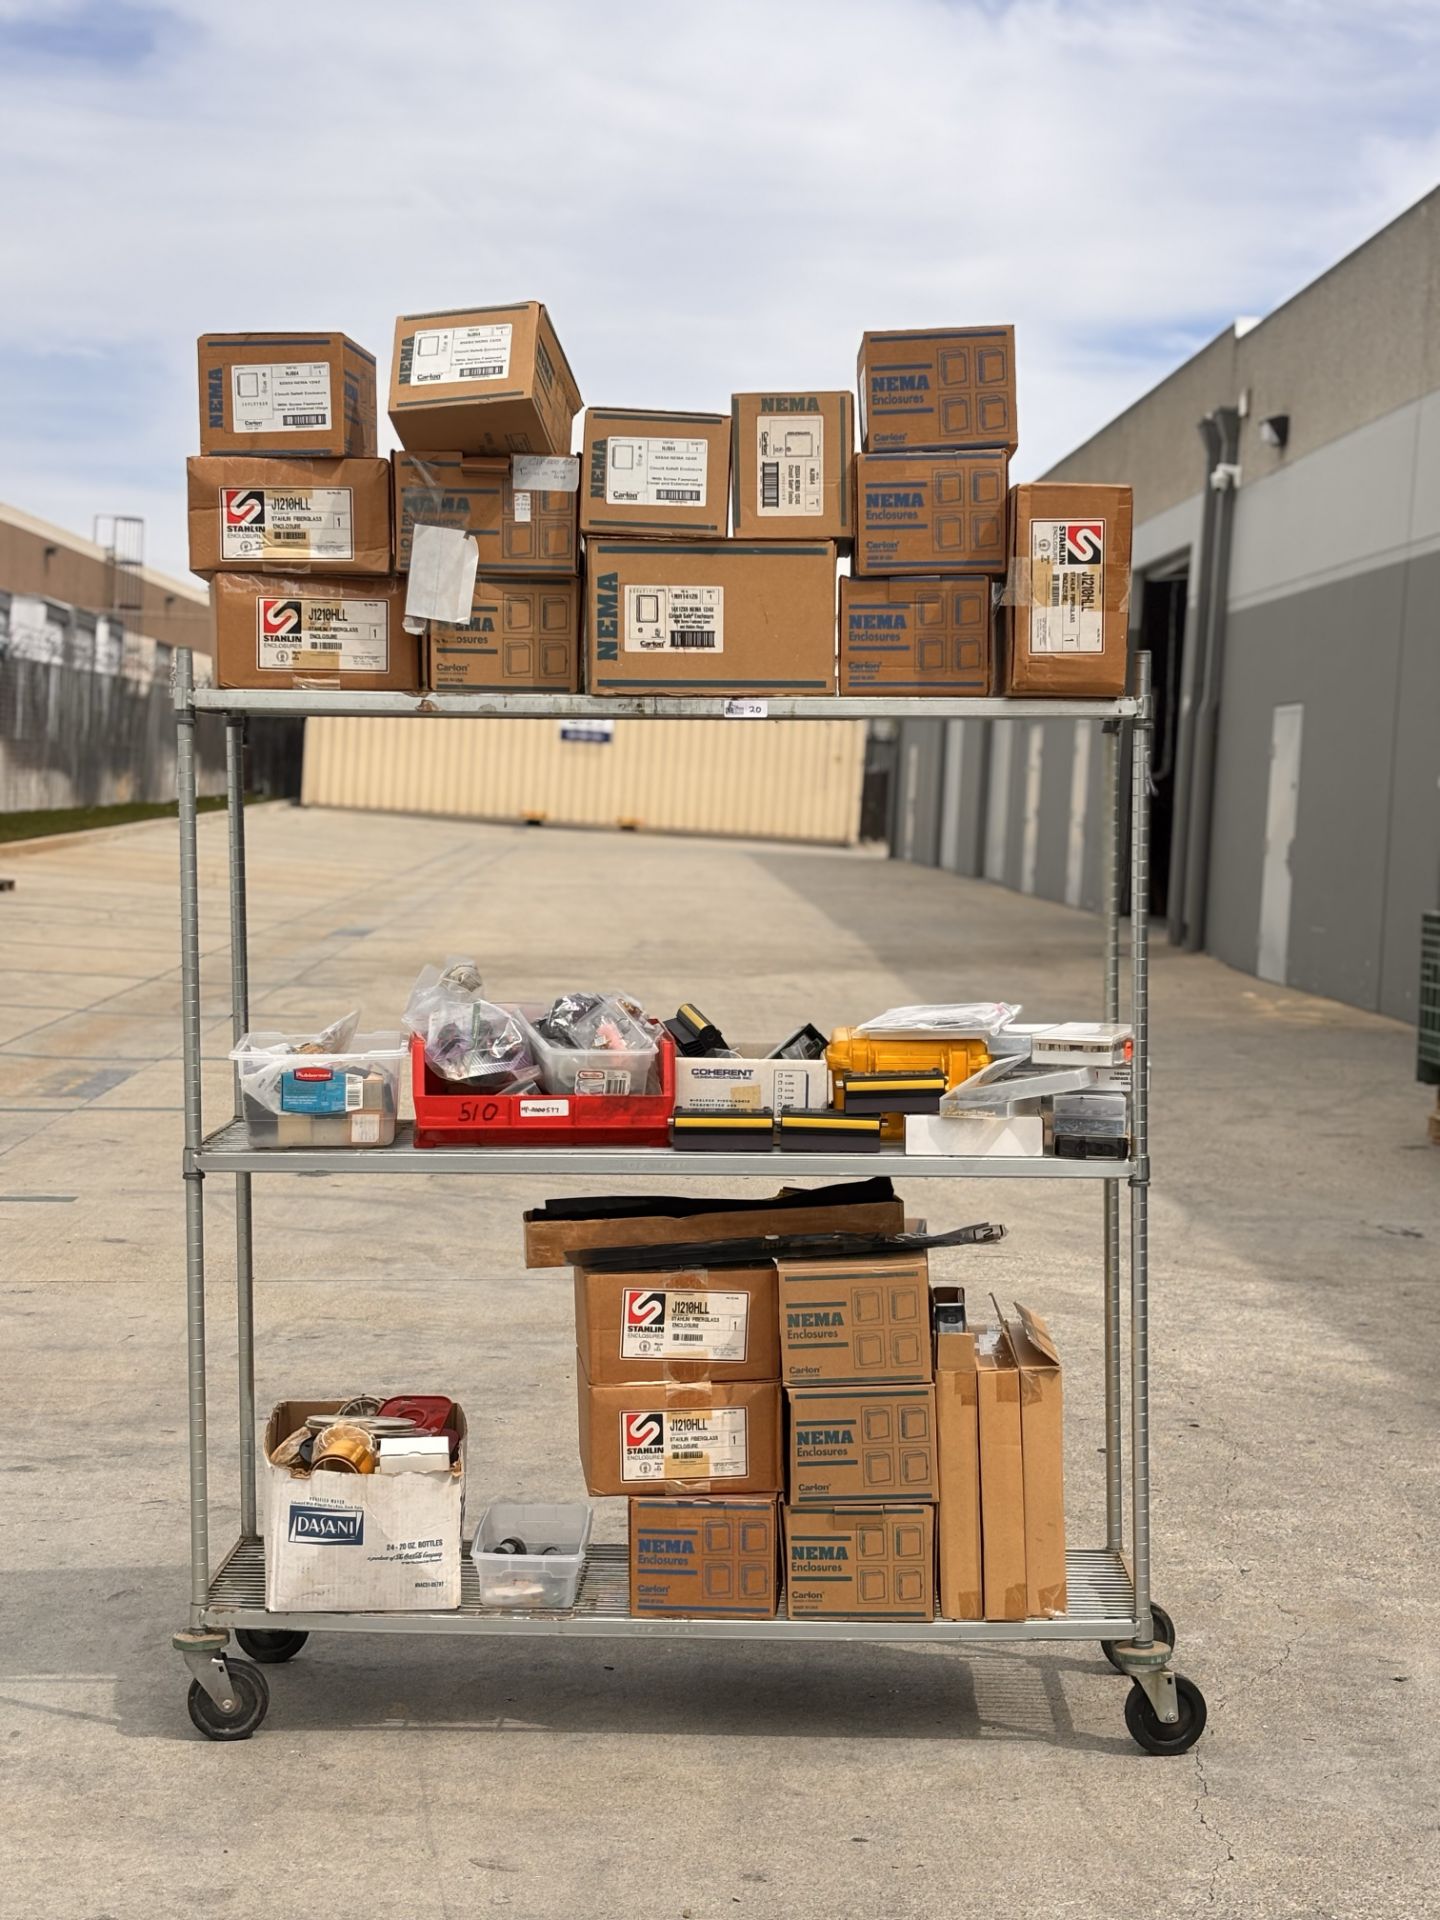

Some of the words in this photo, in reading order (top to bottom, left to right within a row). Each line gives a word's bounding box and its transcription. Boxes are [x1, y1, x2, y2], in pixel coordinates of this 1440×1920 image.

[872, 375, 930, 392] NEMA
[208, 368, 224, 428] NEMA
[872, 394, 924, 405] Enclosures
[760, 397, 820, 412] NEMA
[874, 433, 905, 441] Carlon
[590, 439, 607, 498] NEMA
[271, 497, 312, 511] J1210HLL
[866, 493, 924, 508] NEMA
[866, 509, 918, 520] Enclosures
[336, 518, 341, 527] 1
[227, 525, 266, 533] STAHLIN
[1081, 571, 1095, 612] J1210HLL
[308, 608, 348, 621] J1210HLL
[597, 571, 618, 662] NEMA
[848, 614, 907, 629] NEMA
[373, 628, 377, 638] 1
[849, 630, 900, 641] Enclosures
[263, 635, 302, 643] STAHLIN
[640, 640, 664, 648] Carlon
[436, 663, 468, 671] Carlon
[749, 705, 762, 713] 20
[691, 1068, 754, 1077] COHERENT
[458, 1101, 498, 1121] 510
[672, 1301, 709, 1314] J1210HLL
[787, 1312, 844, 1327] NEMA
[627, 1325, 665, 1333] STAHLIN
[733, 1321, 737, 1330] 1
[787, 1329, 838, 1339] Enclosures
[789, 1366, 820, 1374] Carlon
[670, 1418, 708, 1431] J1210HLL
[732, 1435, 736, 1445] 1
[796, 1430, 854, 1445] NEMA
[797, 1446, 848, 1457] Enclosures
[798, 1483, 829, 1491] Carlon
[297, 1516, 354, 1535] DASANI
[386, 1543, 395, 1551] 24
[418, 1539, 443, 1548] BOTTLES
[639, 1539, 695, 1554] NEMA
[791, 1546, 849, 1560] NEMA
[639, 1554, 688, 1565] Enclosures
[791, 1561, 842, 1572] Enclosures
[638, 1585, 669, 1593] Carlon
[791, 1591, 823, 1599] Carlon
